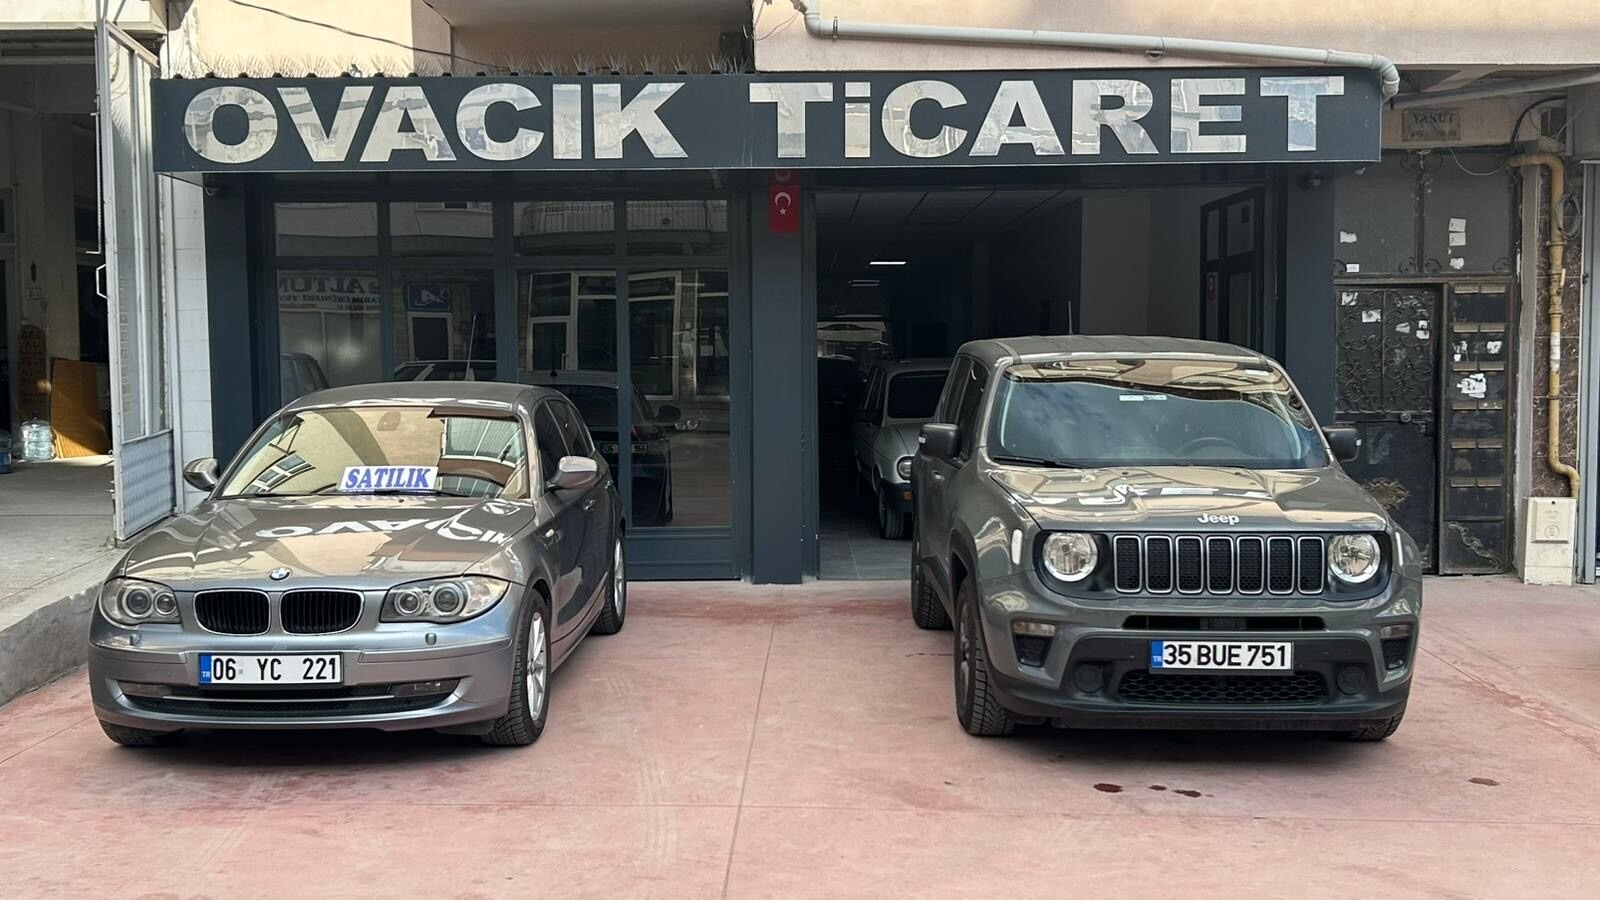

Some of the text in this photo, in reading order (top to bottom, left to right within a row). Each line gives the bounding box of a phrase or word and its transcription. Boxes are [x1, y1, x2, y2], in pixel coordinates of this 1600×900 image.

[184, 83, 689, 164] OVACIK
[344, 467, 432, 489] SATILIK
[1197, 512, 1240, 525] Jeep
[1162, 643, 1191, 667] 35
[1196, 643, 1241, 667] BUE
[1246, 643, 1287, 667] 751
[213, 657, 236, 681] 06
[256, 657, 282, 681] YC
[303, 657, 336, 680] 221
